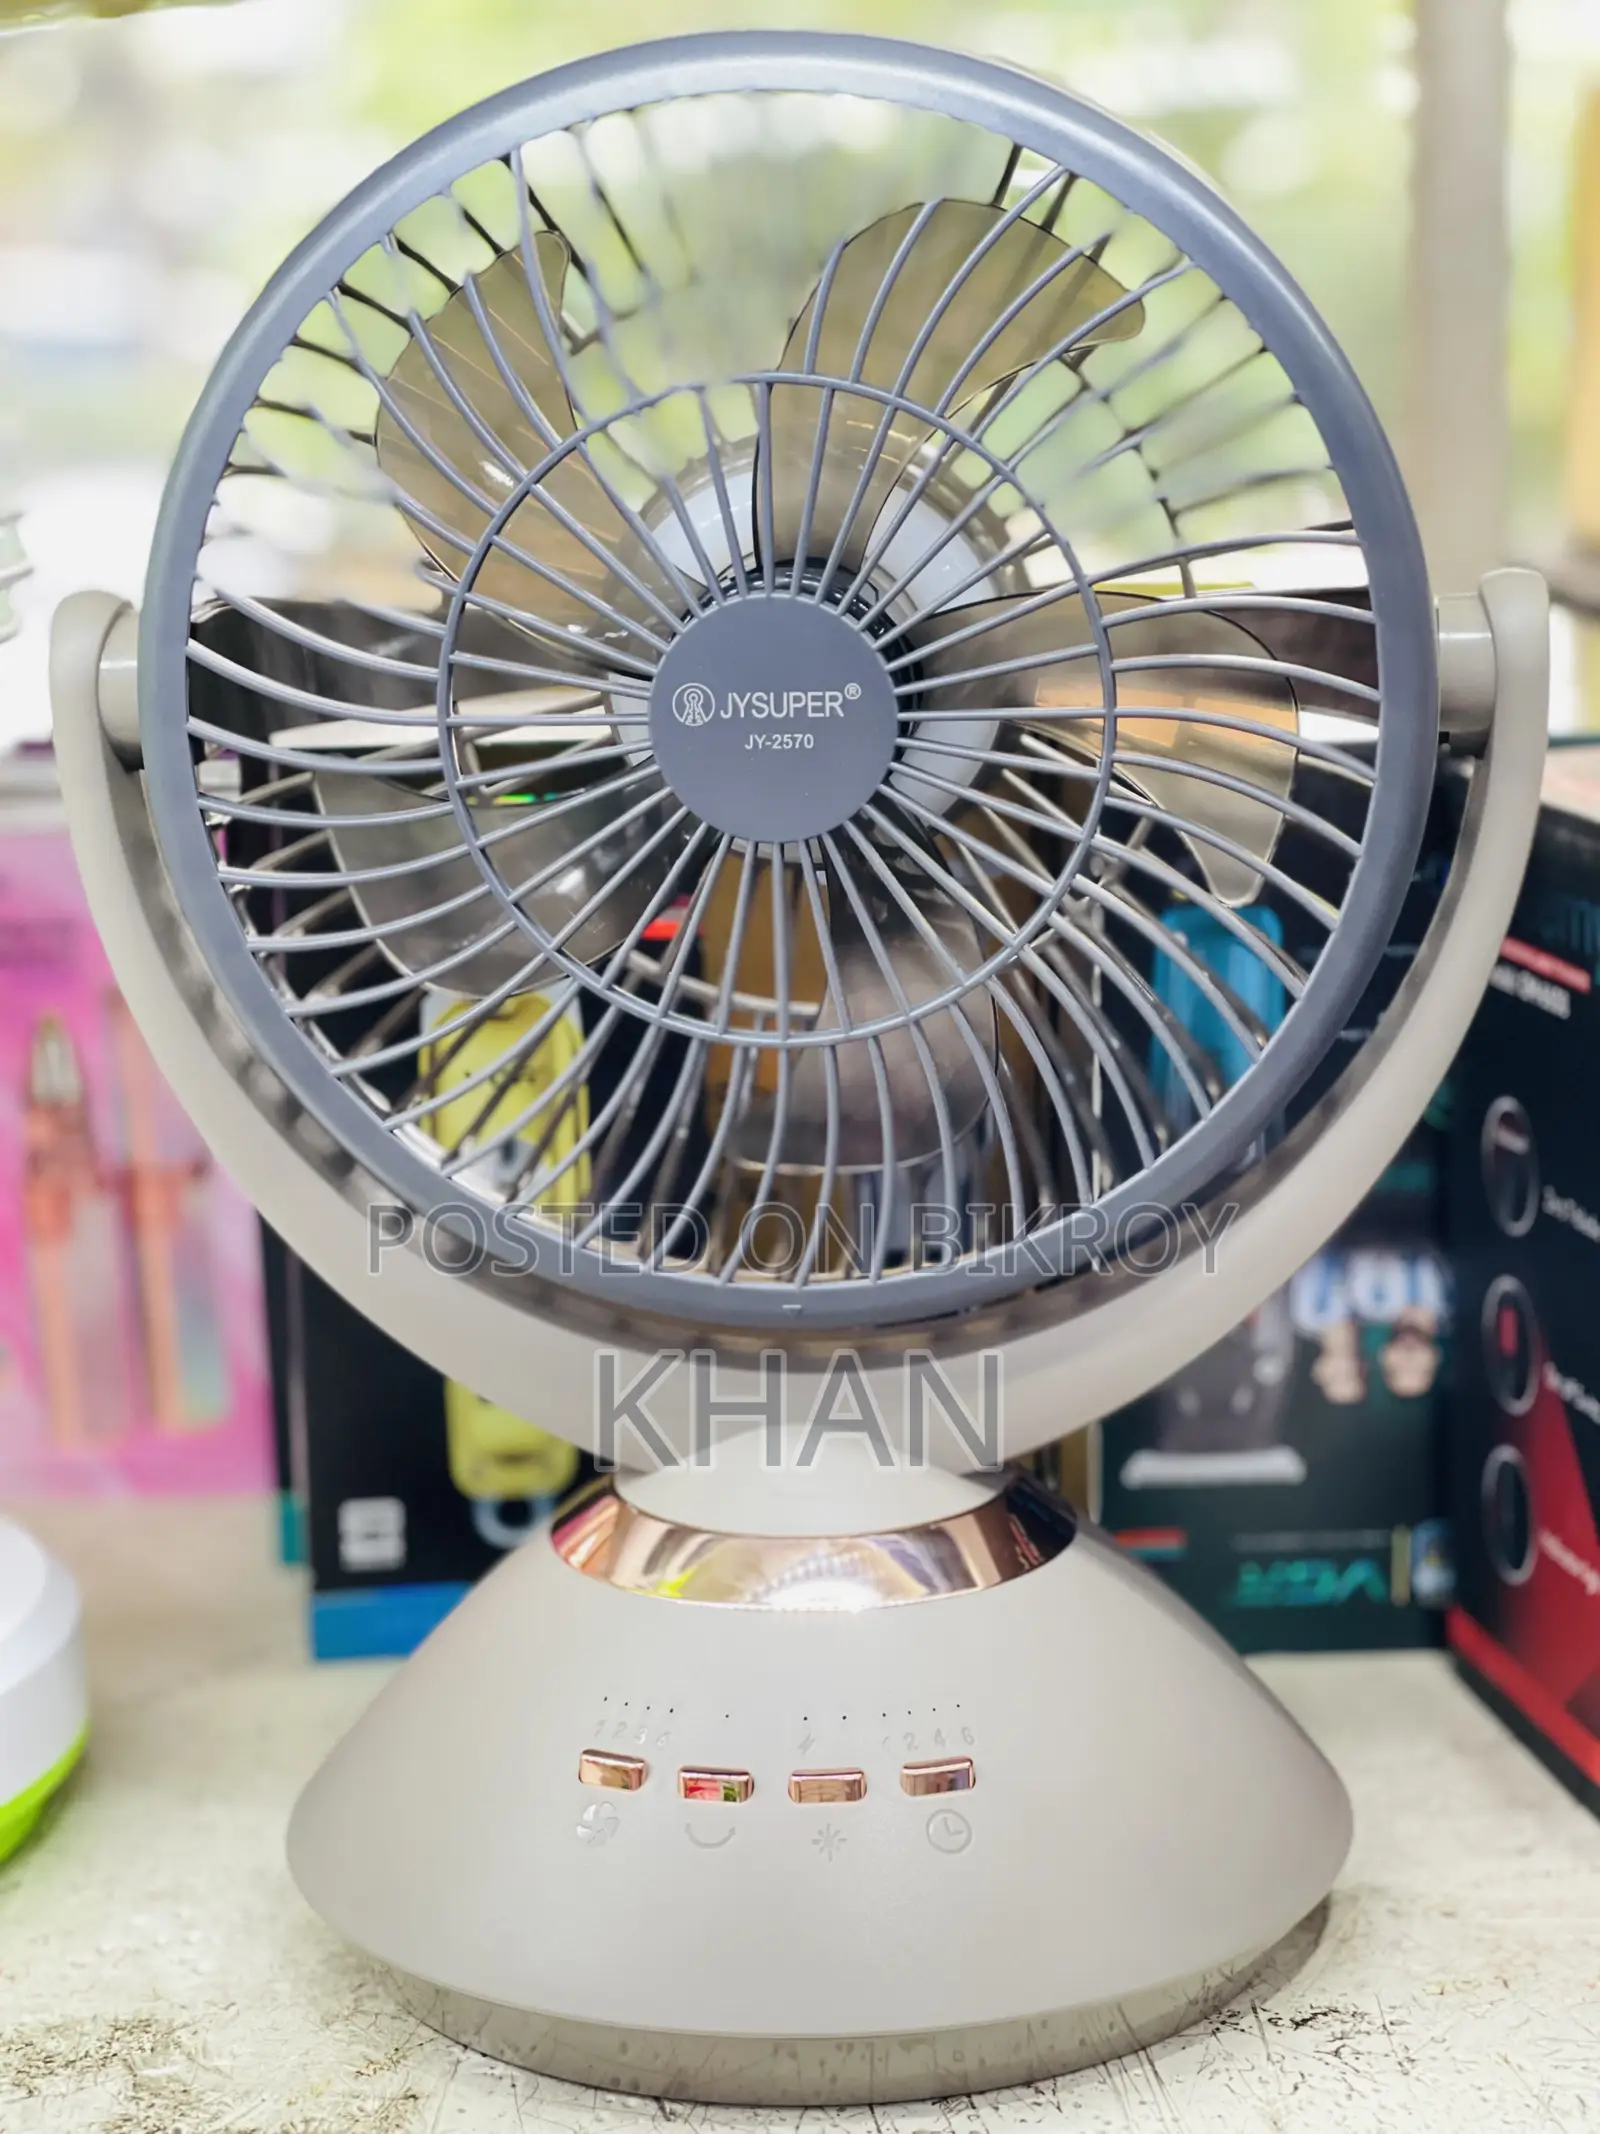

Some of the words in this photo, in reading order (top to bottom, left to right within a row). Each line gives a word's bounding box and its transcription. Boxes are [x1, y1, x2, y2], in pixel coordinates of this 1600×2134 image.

[744, 734, 814, 750] JY-2570
[611, 1721, 628, 1740] 2
[633, 1725, 649, 1746] 3
[903, 1732, 918, 1751] 2
[933, 1727, 947, 1749] 4
[960, 1726, 976, 1747] 6
